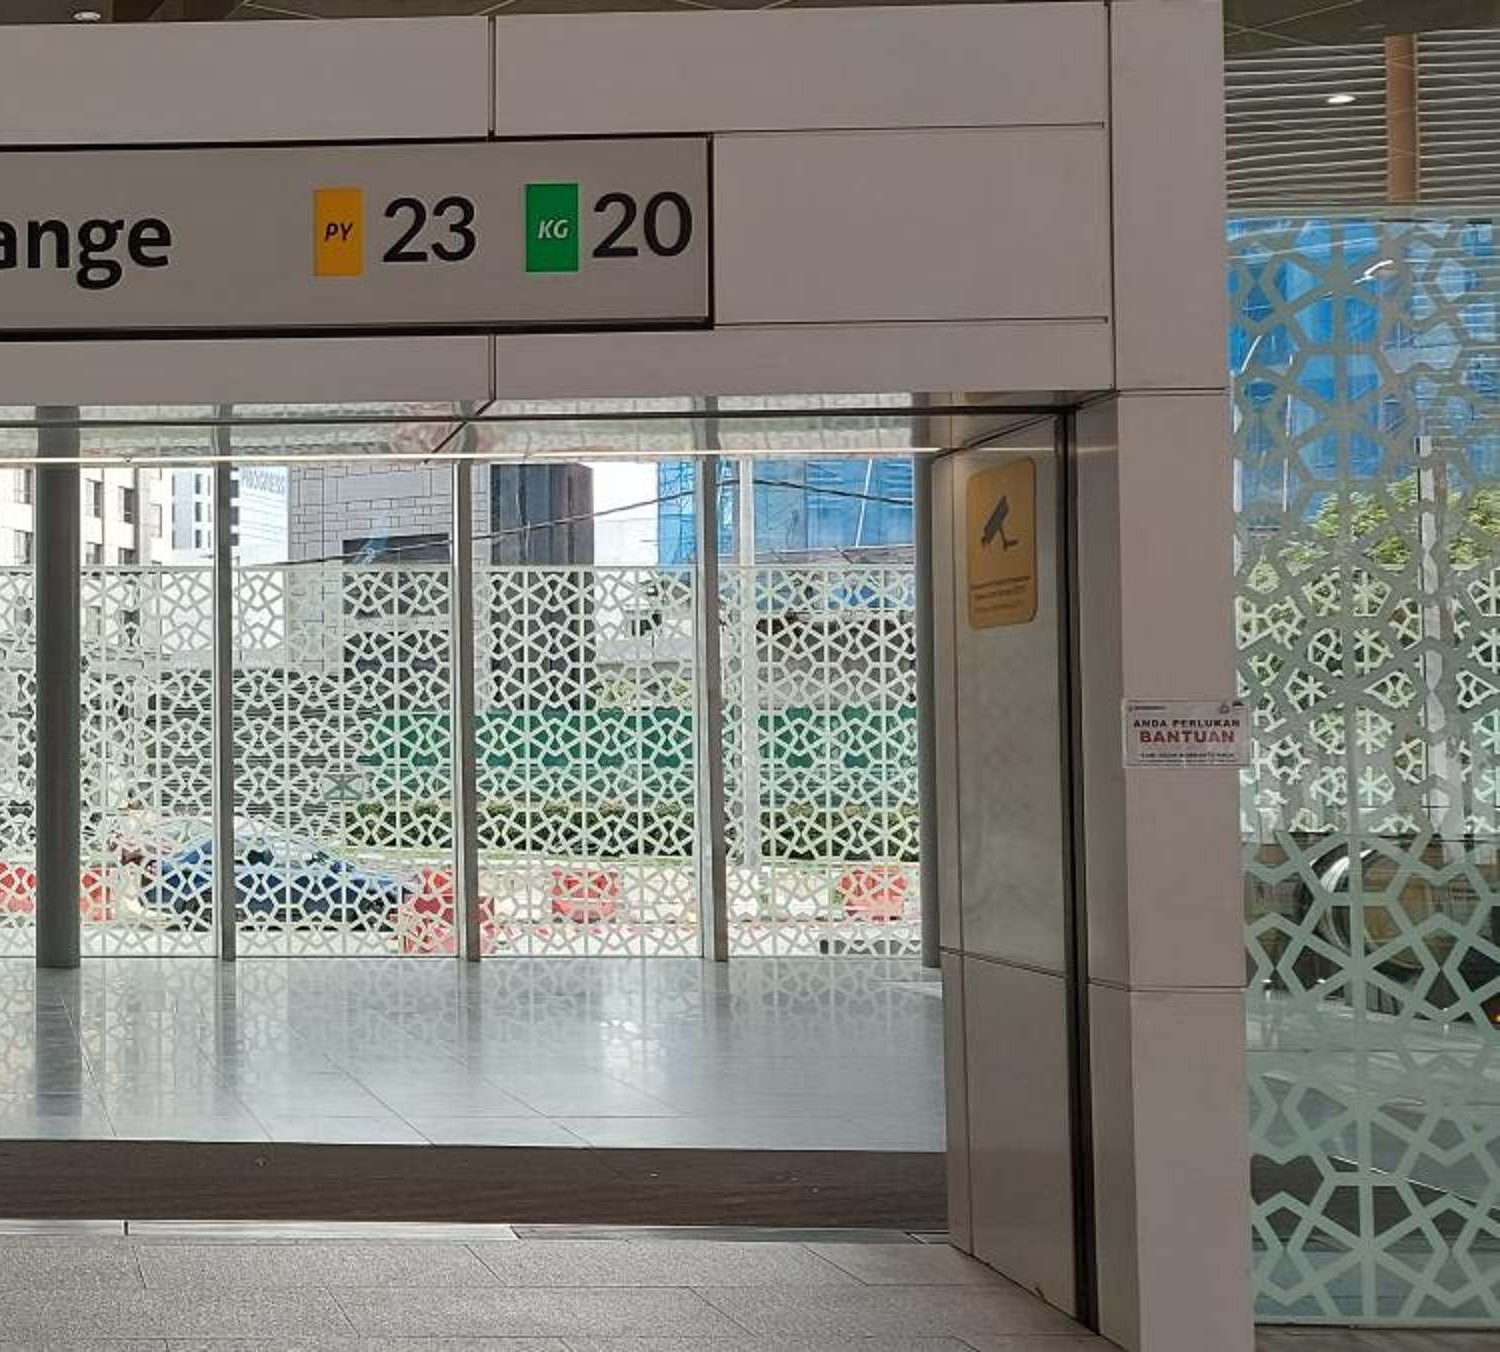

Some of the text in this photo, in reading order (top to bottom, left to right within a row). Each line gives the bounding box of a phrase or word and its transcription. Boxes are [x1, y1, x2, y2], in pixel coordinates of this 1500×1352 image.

[324, 196, 477, 263] PY 23
[537, 191, 693, 258] KG 20
[1133, 719, 1241, 728] ANDA PERLUKAN
[1139, 731, 1235, 743] BANTUAN
